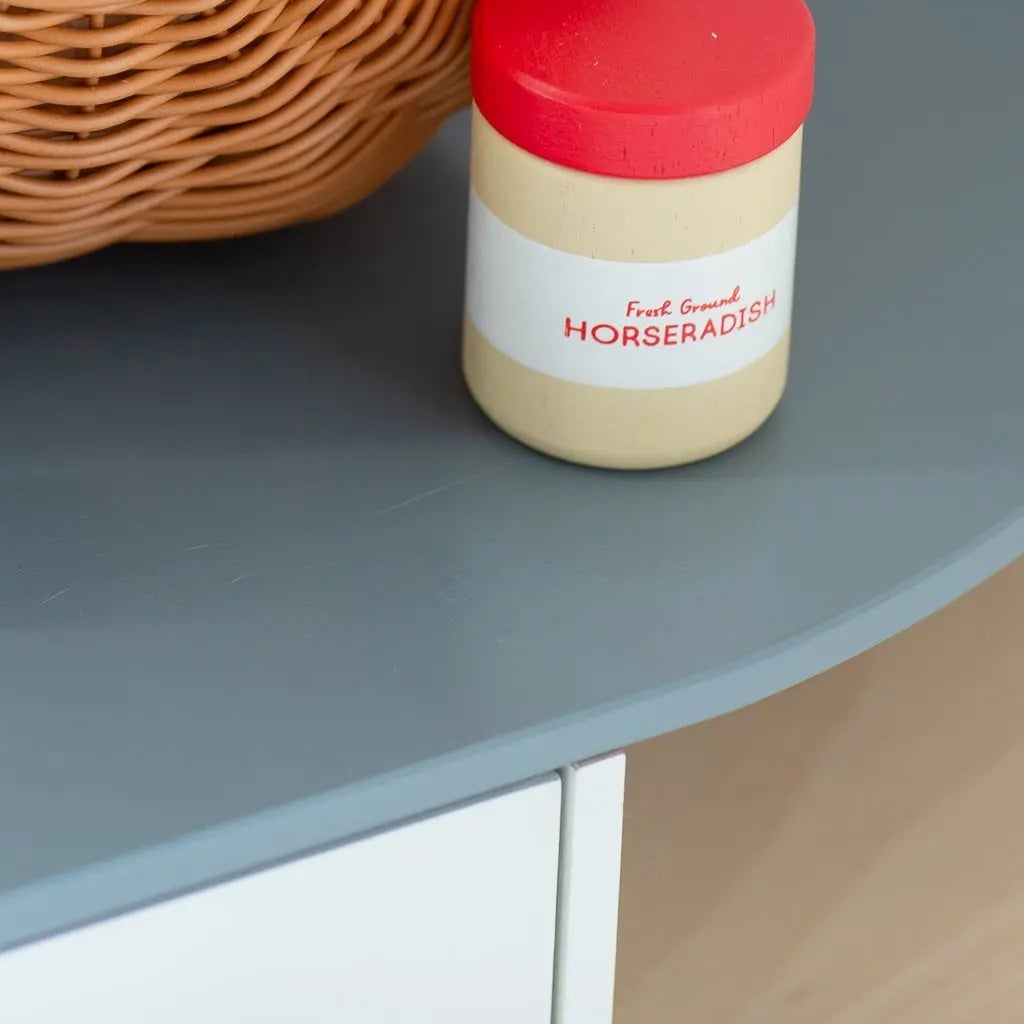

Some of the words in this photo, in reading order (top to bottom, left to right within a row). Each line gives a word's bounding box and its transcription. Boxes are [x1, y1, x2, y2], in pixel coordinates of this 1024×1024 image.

[564, 288, 777, 348] HORSERADISH
[625, 299, 672, 318] Fresh
[679, 285, 740, 316] Ground
